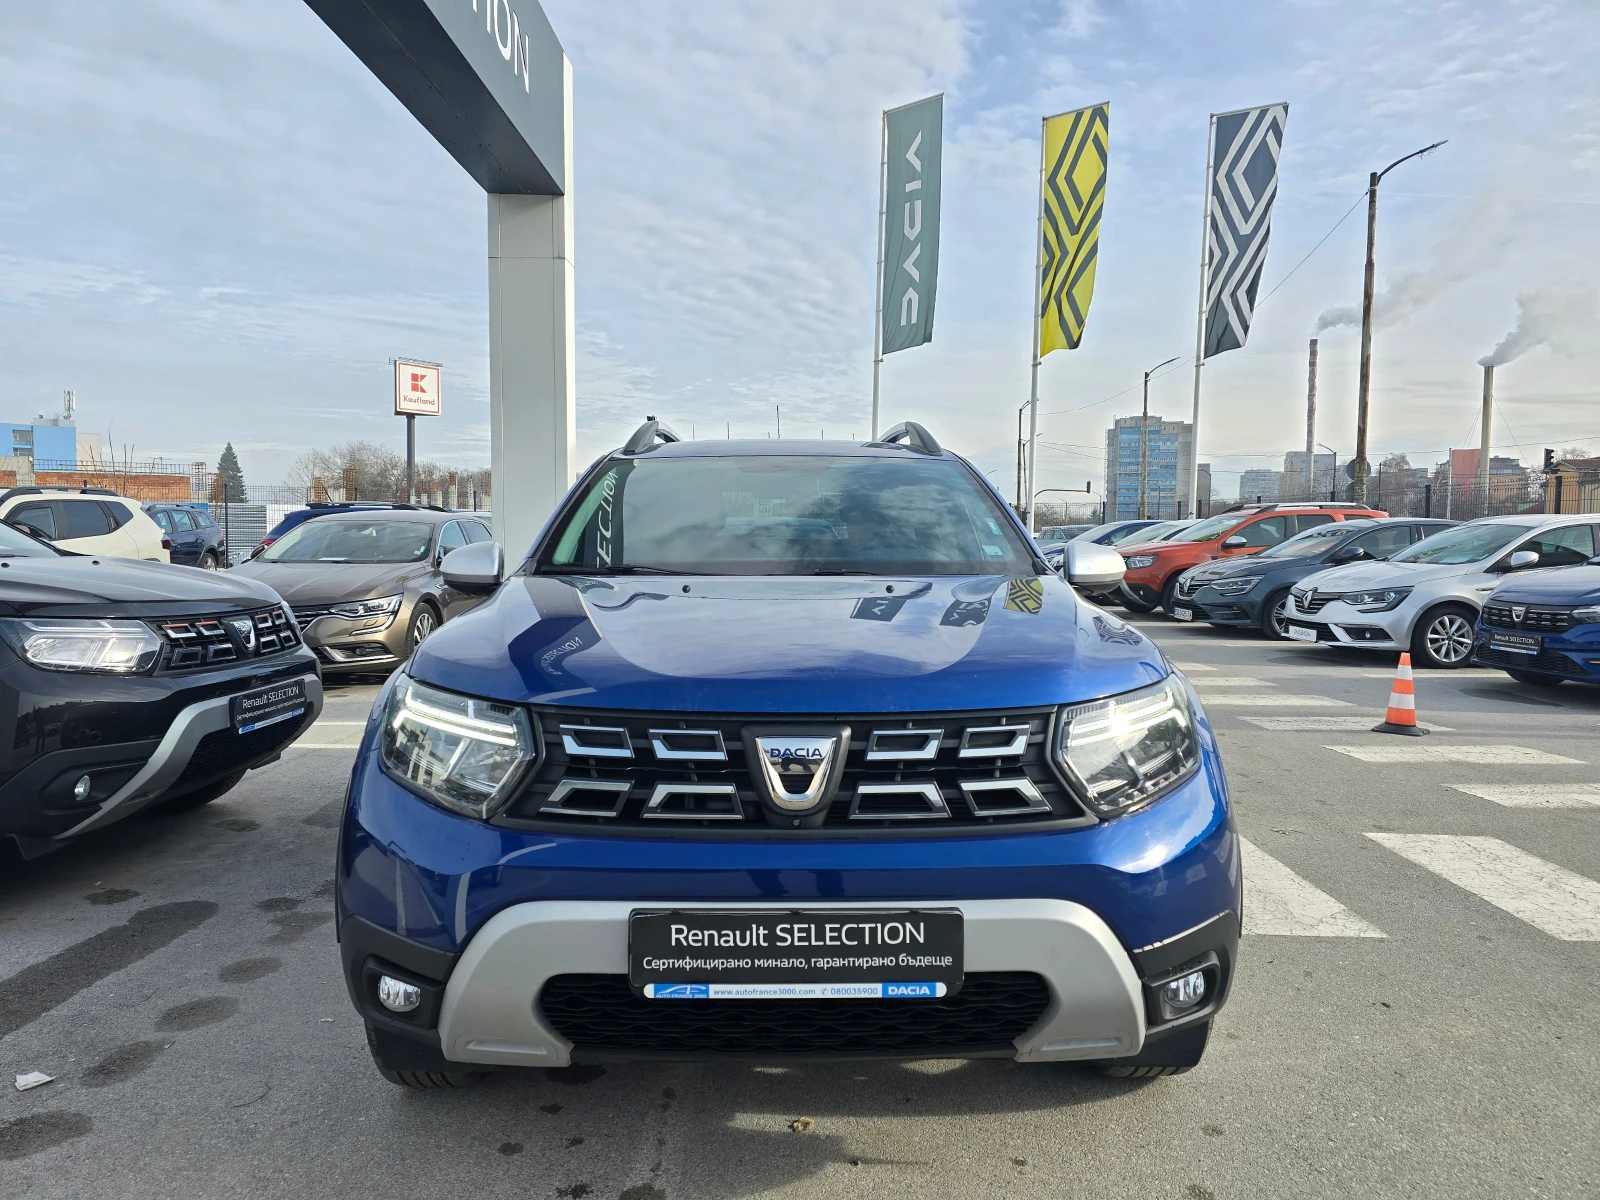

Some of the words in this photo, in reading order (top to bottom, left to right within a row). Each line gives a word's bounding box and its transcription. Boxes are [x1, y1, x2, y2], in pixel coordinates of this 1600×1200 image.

[472, 0, 530, 95] ON
[403, 395, 435, 405] Kaufland
[243, 694, 267, 709] Renault
[268, 686, 299, 703] SELECTION
[770, 748, 823, 758] DACIA
[670, 924, 769, 947] Renault
[775, 922, 925, 946] SELECTION
[643, 956, 752, 971] Сертифицирано
[754, 957, 808, 969] минало,
[811, 955, 896, 970] гарантирано
[898, 953, 953, 967] бъдеще
[713, 987, 816, 996] www.autofrance3000.com
[830, 987, 878, 996] 080035900
[888, 986, 930, 995] DACIA
